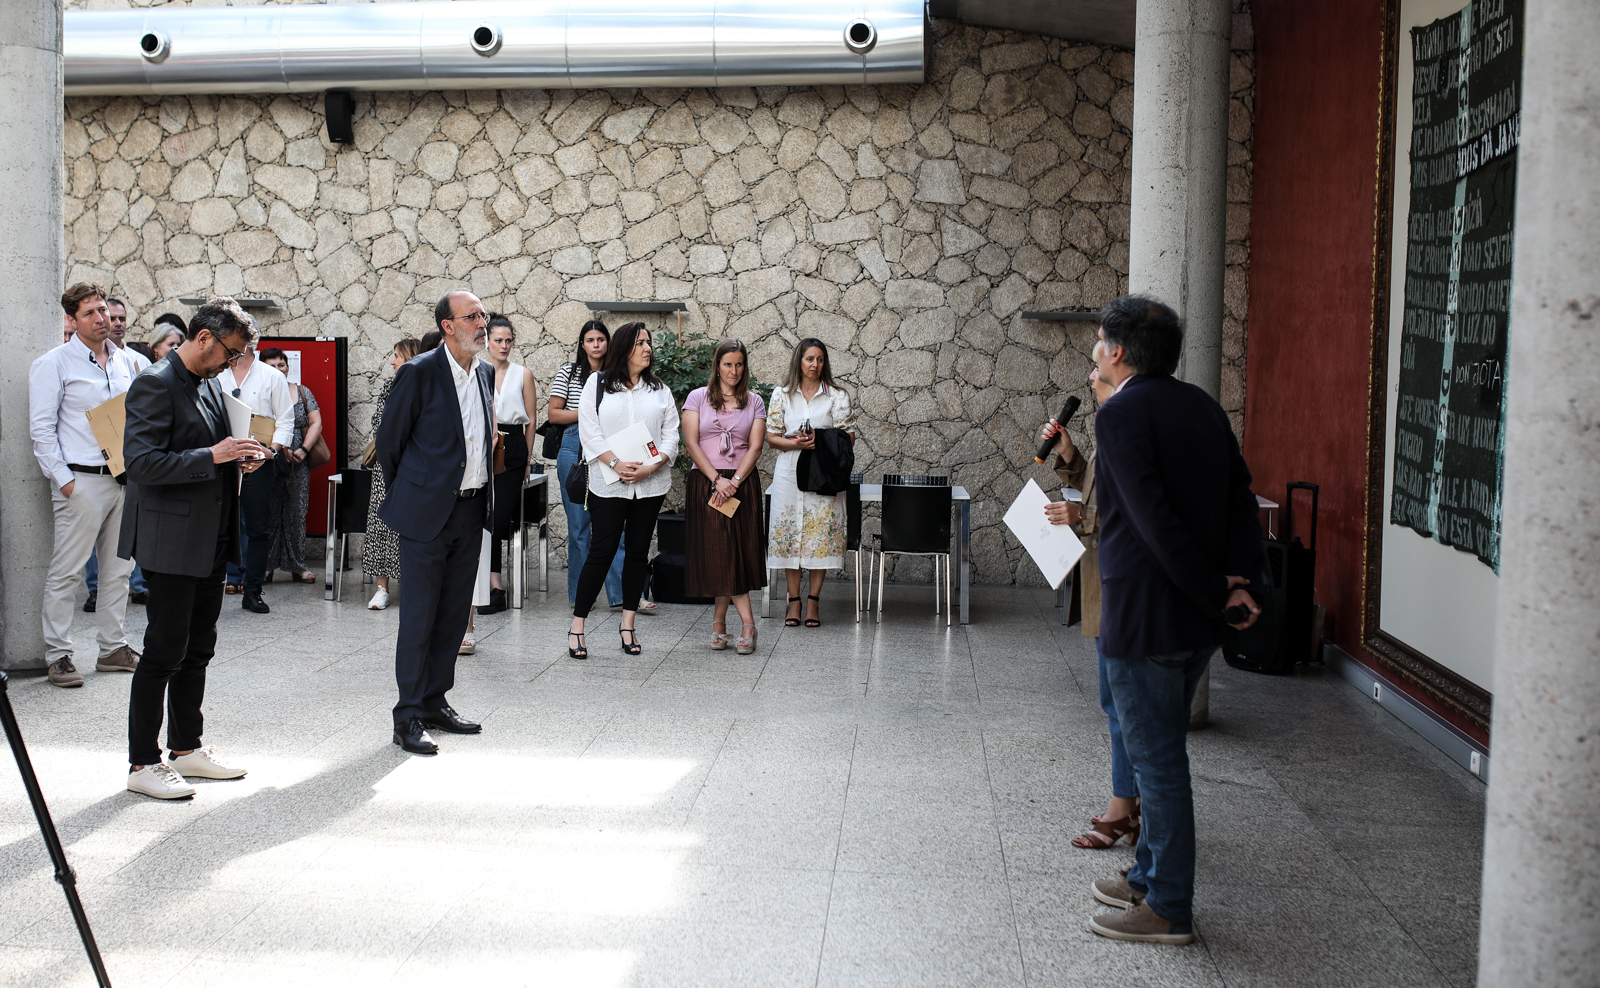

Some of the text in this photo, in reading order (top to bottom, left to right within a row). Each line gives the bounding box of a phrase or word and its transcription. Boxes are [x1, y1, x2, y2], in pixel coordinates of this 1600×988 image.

[1484, 14, 1514, 65] DESTA
[1413, 94, 1431, 126] CELA
[1413, 127, 1432, 158] VEJO
[1481, 129, 1493, 166] DA
[1406, 243, 1423, 273] QUE
[1461, 313, 1480, 344] LUZ
[1481, 314, 1496, 346] DO
[1472, 359, 1502, 391] JOTA
